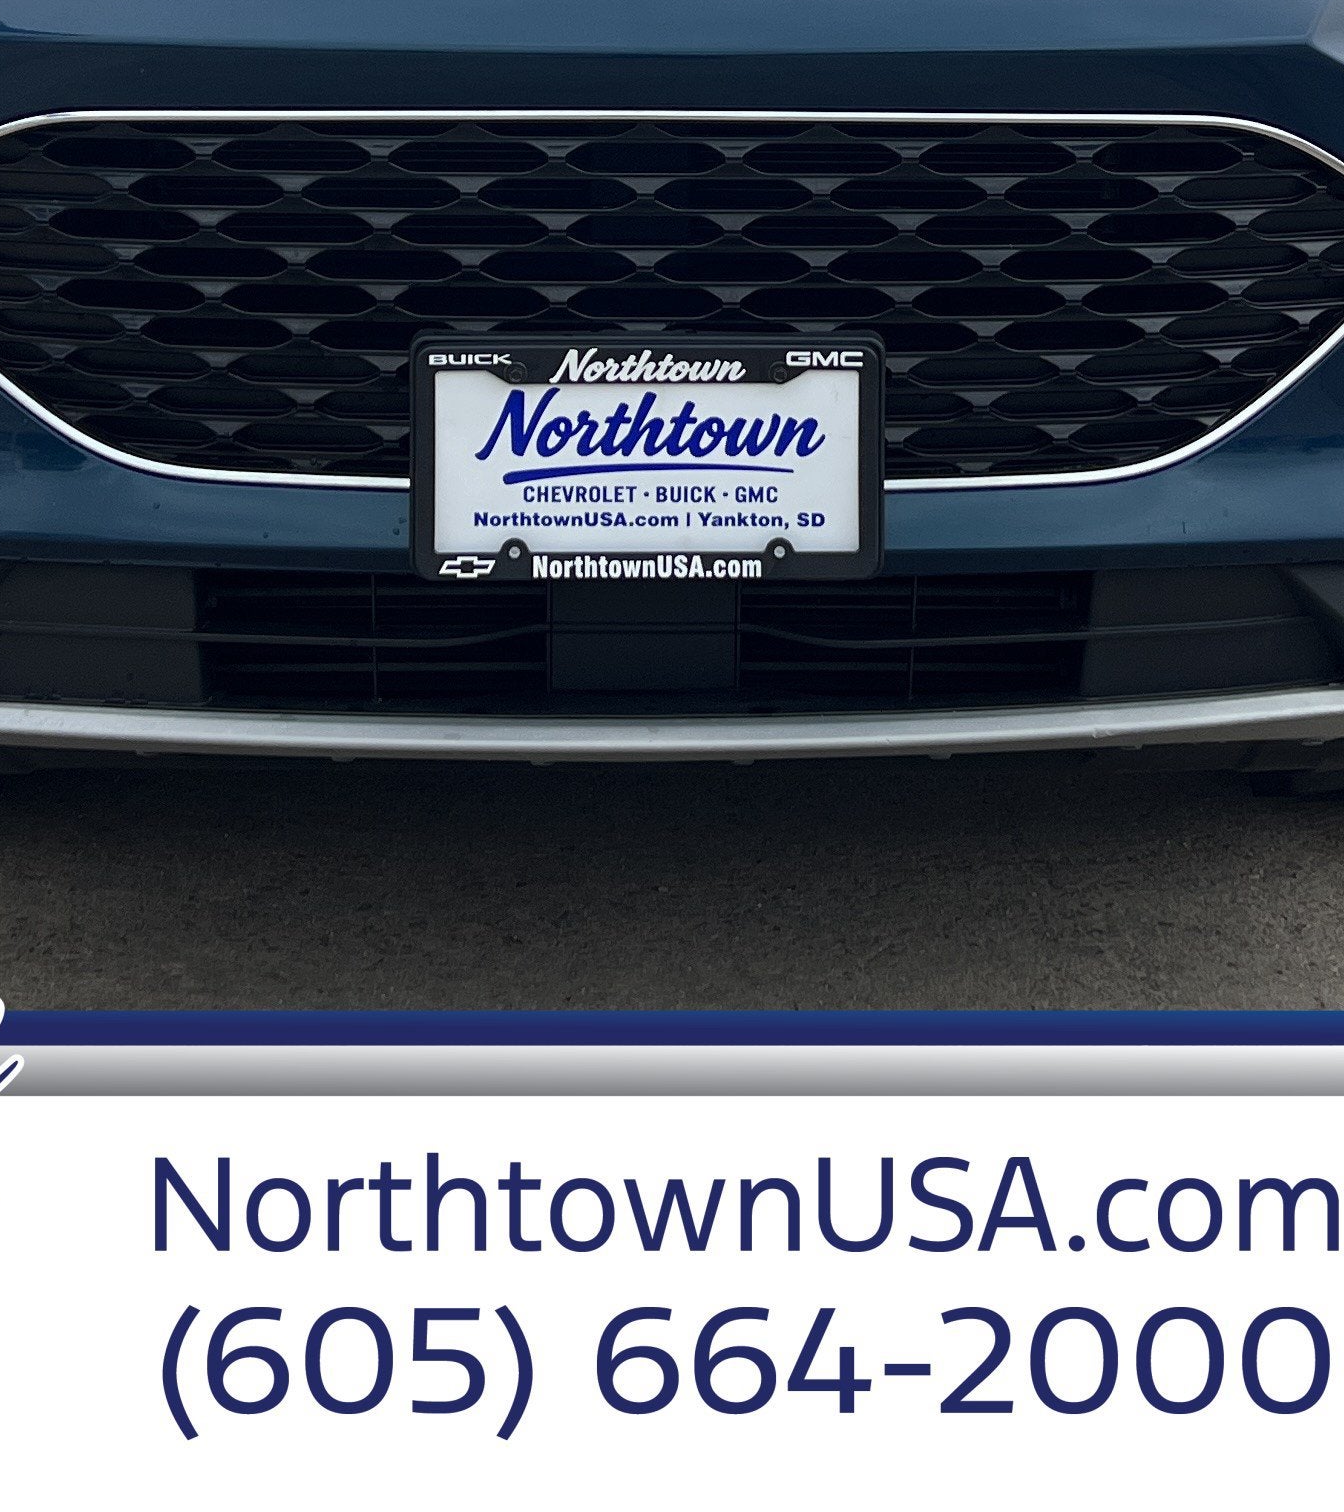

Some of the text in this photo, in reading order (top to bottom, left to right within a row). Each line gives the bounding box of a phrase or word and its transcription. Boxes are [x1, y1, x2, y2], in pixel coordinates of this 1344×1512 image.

[428, 353, 512, 366] BUICK
[548, 347, 747, 383] Northtown
[785, 350, 864, 368] GMC
[474, 387, 826, 461] Northtown
[523, 485, 778, 504] CHEVROLET BUICK GMC
[473, 511, 826, 530] NorthtownUSA.com Yankton, SD
[532, 554, 762, 579] NorthtownUSA.com
